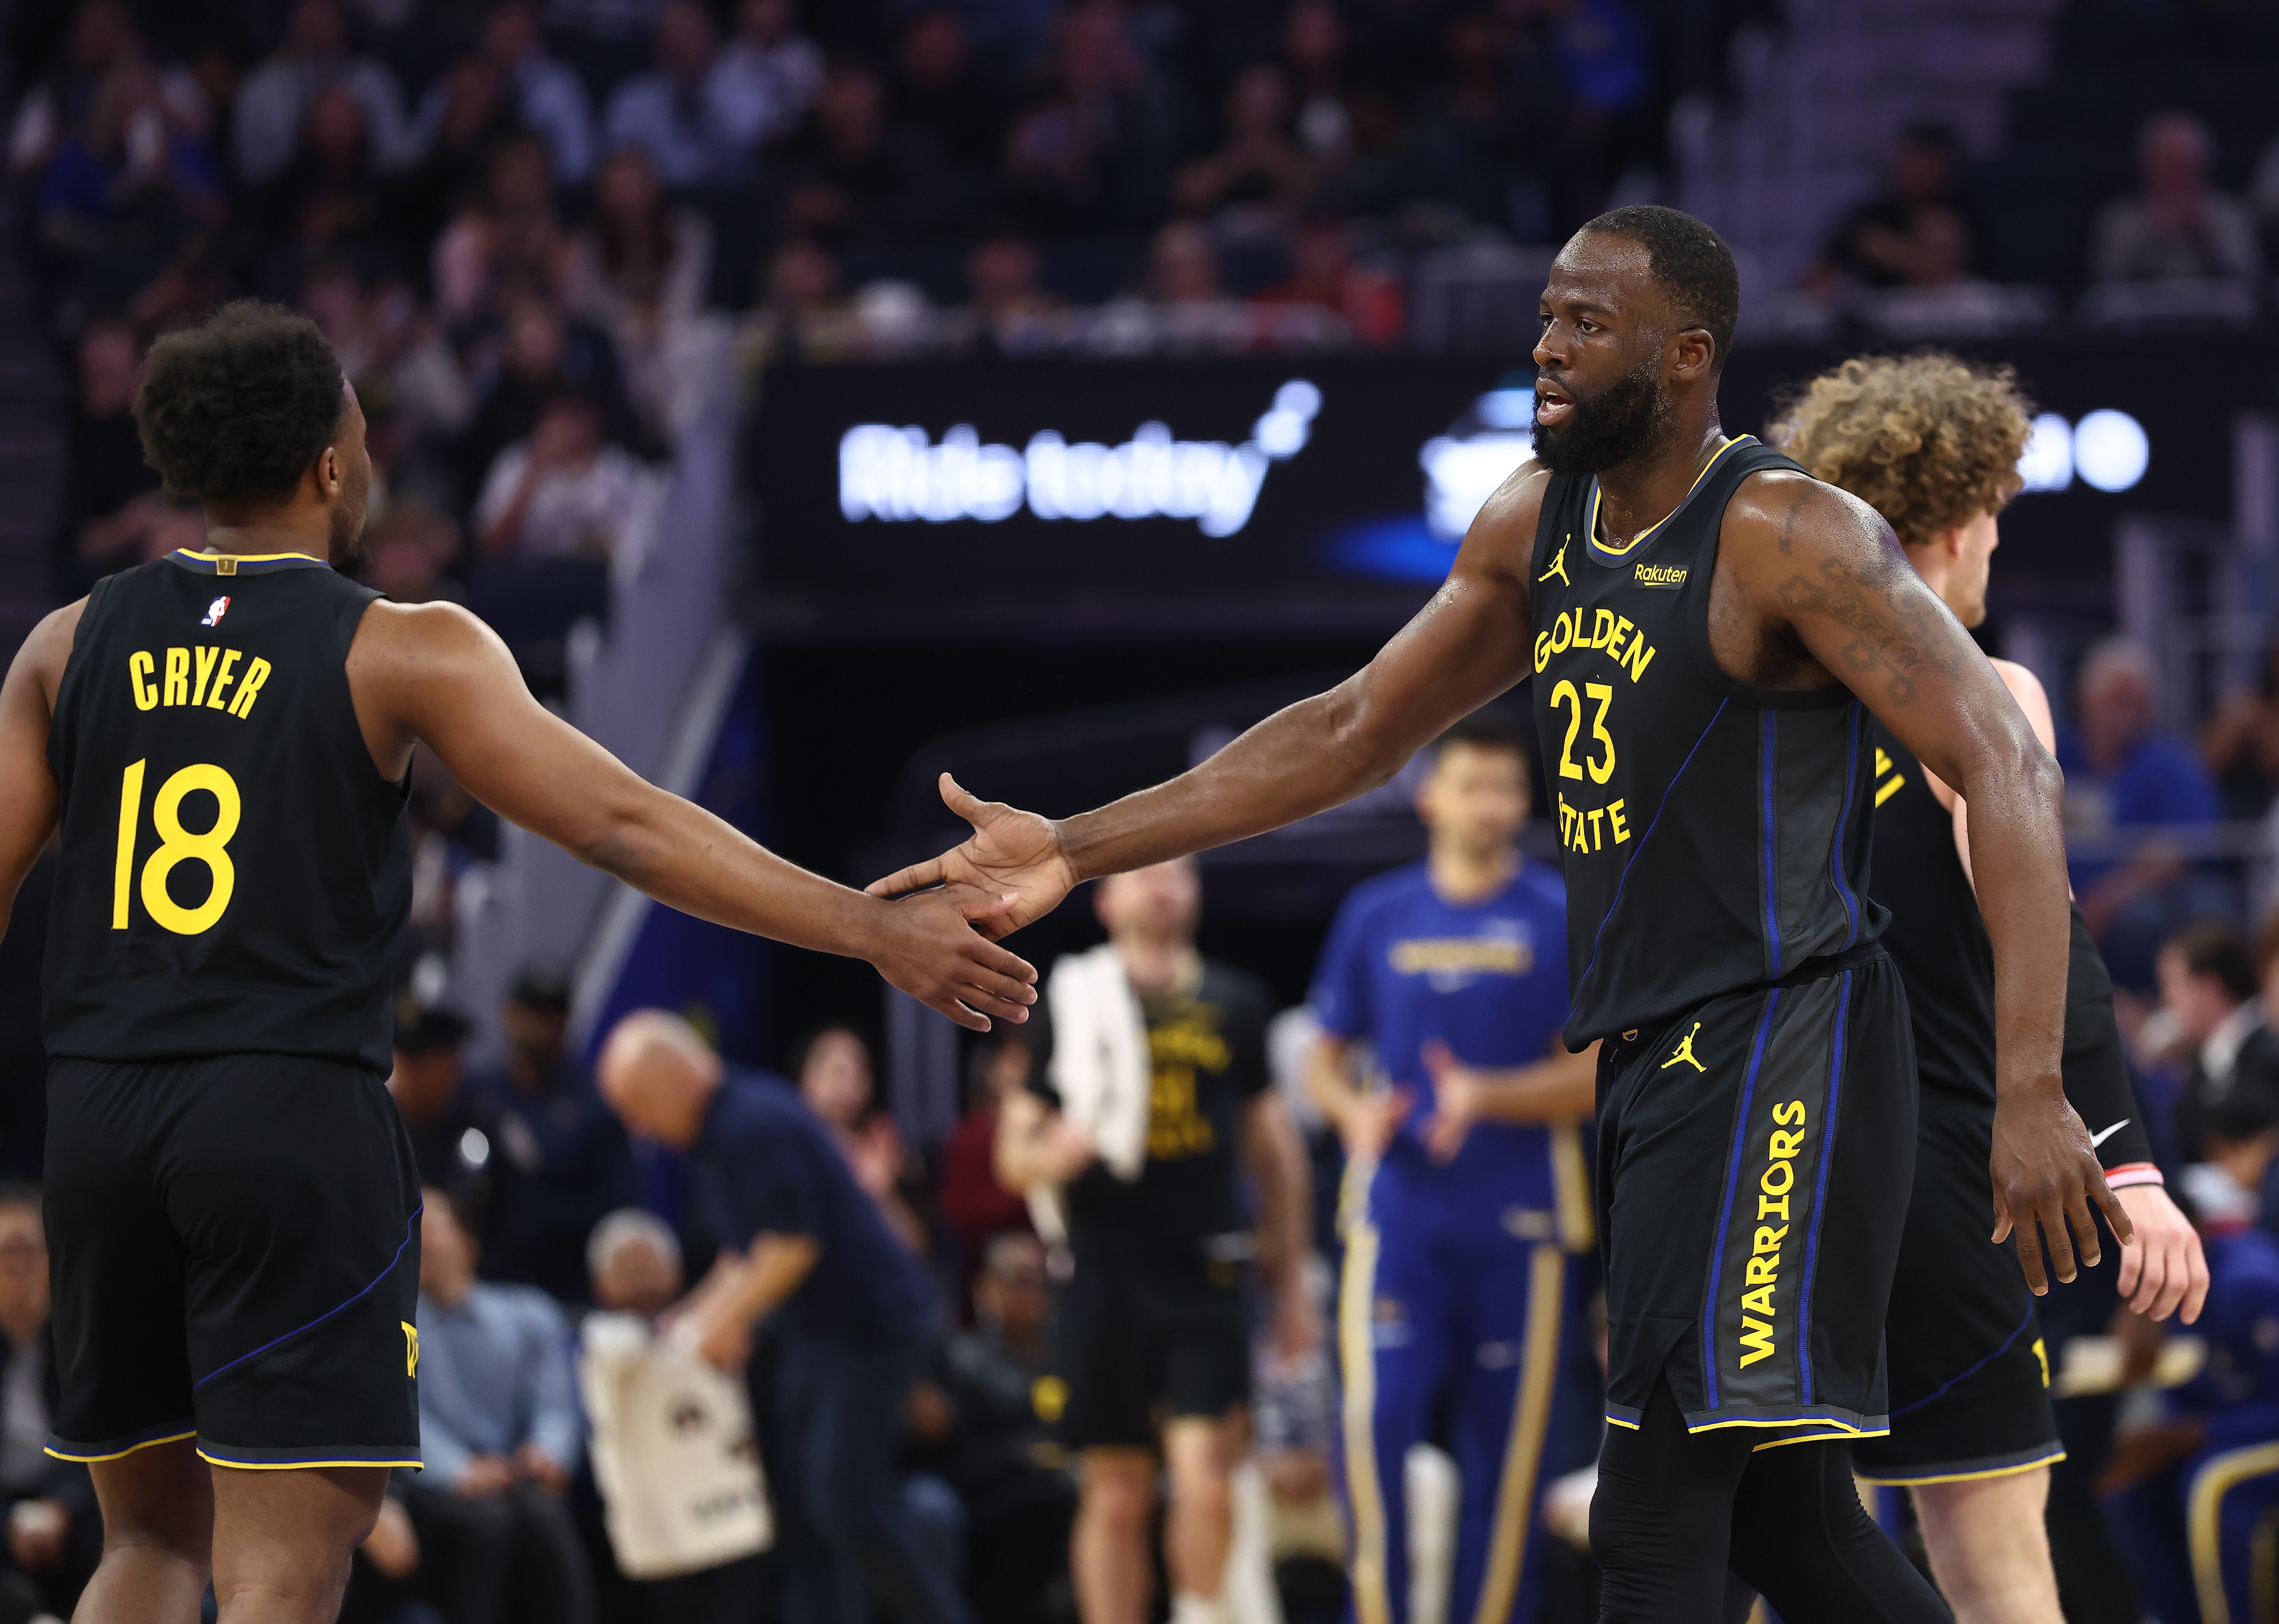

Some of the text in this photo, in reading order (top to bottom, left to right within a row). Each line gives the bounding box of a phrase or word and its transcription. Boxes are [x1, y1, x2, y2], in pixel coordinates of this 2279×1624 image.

[1634, 564, 1687, 583] Rakuten
[129, 645, 272, 720] CRYER
[1534, 607, 1656, 683] GOLDEN
[1550, 679, 1616, 785] 23
[112, 758, 241, 936] 18
[1558, 791, 1631, 854] STATE
[1739, 1100, 1806, 1368] WARRIORS
